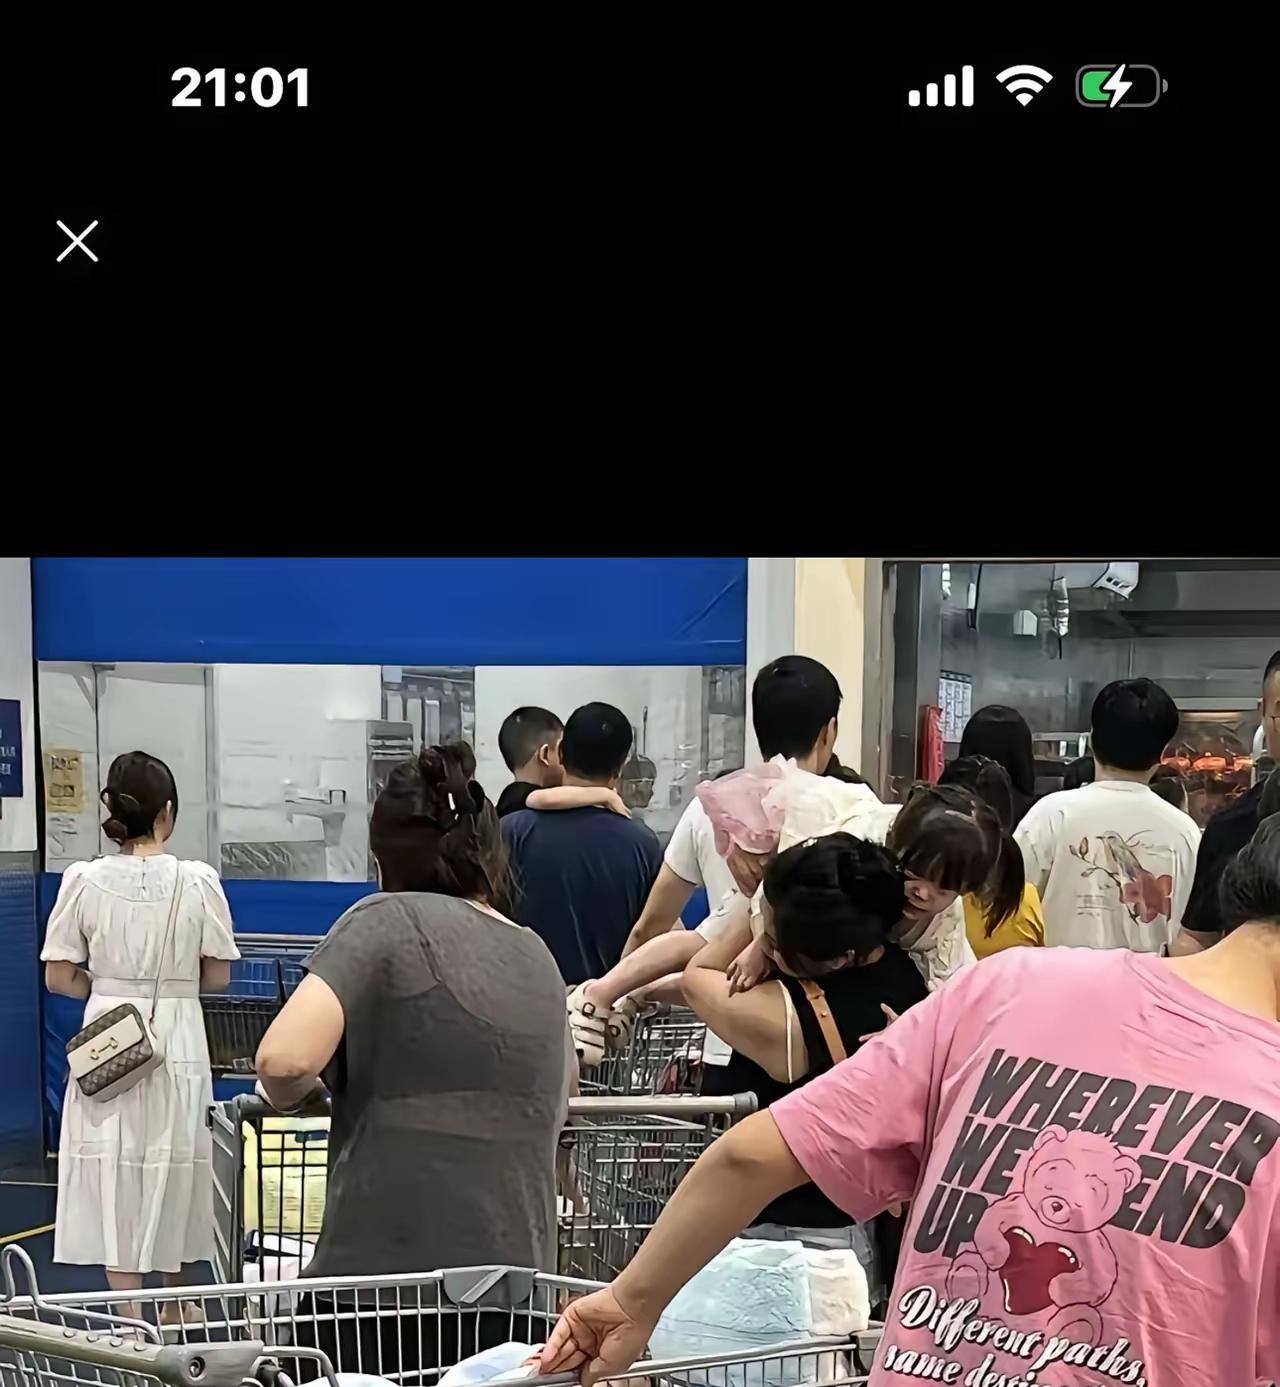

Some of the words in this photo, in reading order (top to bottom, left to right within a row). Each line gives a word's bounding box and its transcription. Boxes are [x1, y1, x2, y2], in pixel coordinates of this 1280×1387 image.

[968, 1048, 1280, 1187] WHEREVER
[941, 1115, 1038, 1196] WE
[1109, 1154, 1246, 1249] END
[913, 1183, 989, 1258] UP
[898, 1284, 1044, 1351] Different
[884, 1344, 964, 1383] same
